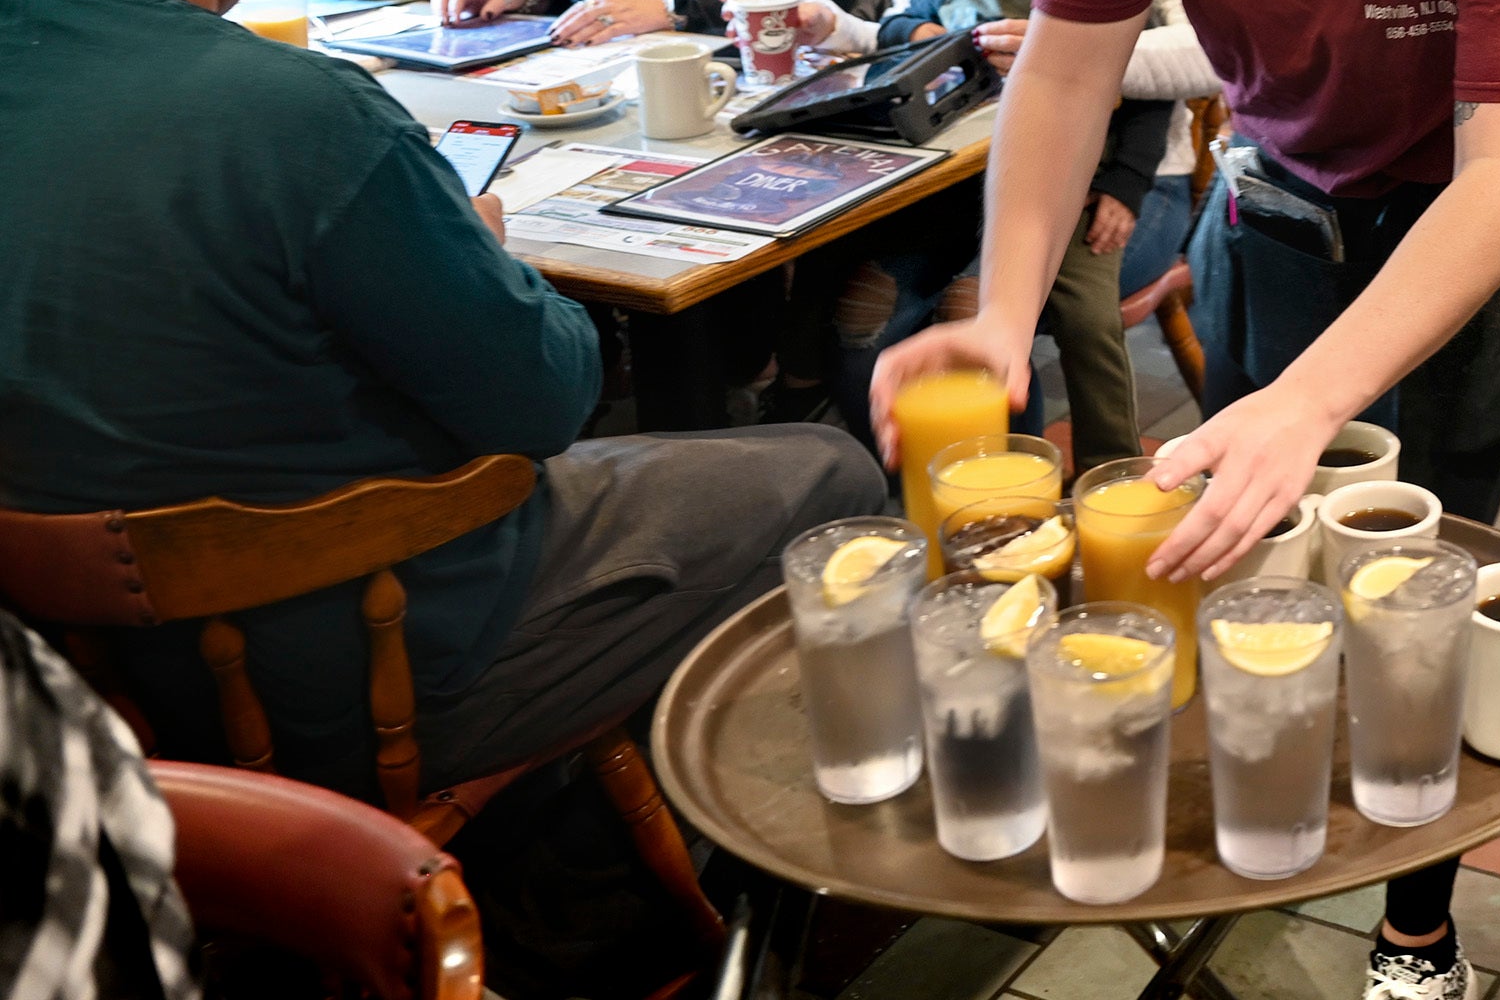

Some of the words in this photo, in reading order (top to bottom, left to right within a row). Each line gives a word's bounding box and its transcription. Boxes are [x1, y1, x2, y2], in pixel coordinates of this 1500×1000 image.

[1420, 0, 1436, 16] NJ
[752, 143, 896, 175] GATEWAY
[735, 173, 807, 192] DINER
